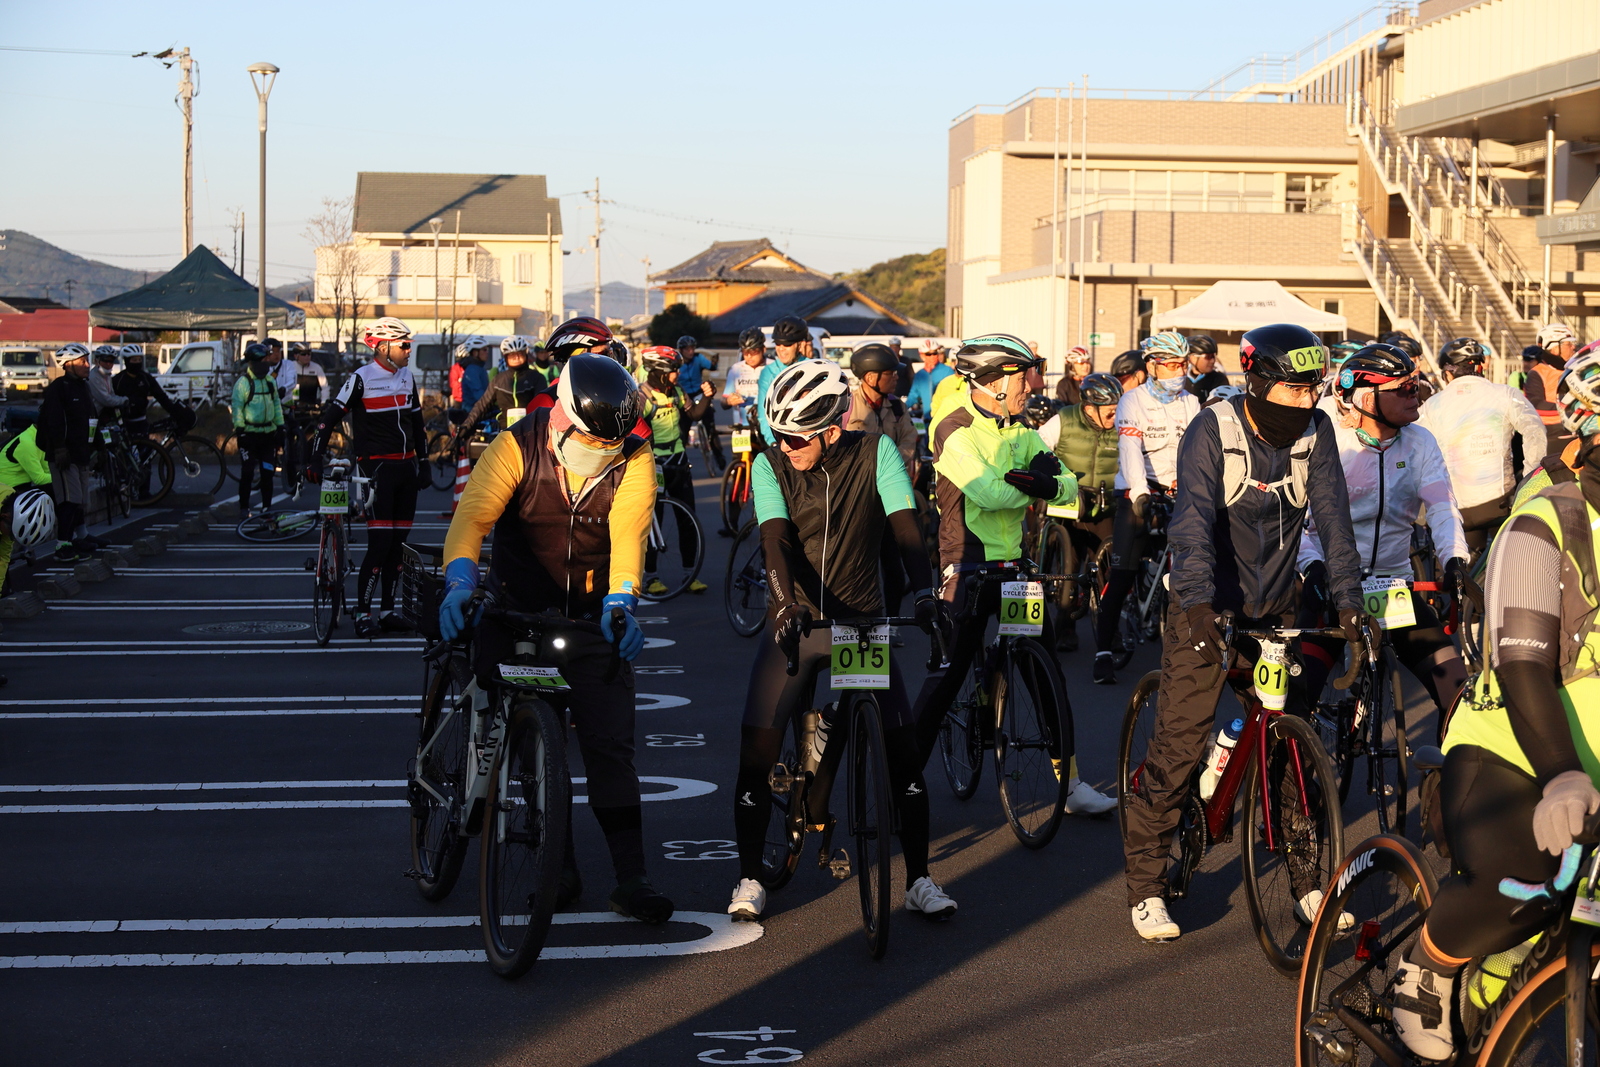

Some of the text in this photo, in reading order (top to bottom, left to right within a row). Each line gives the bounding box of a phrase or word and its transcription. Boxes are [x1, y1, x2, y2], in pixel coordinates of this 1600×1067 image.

[554, 333, 599, 348] HJC
[1295, 348, 1325, 367] 012
[1567, 378, 1591, 404] JAPAN
[324, 493, 346, 504] 034
[769, 569, 785, 602] SHIMANO
[1007, 601, 1041, 620] 018
[1367, 591, 1408, 614] 016
[833, 634, 855, 642] CYCLE
[1498, 637, 1549, 650] Santini
[838, 647, 884, 669] 015
[1258, 664, 1288, 690] 01
[644, 732, 707, 748] 62
[661, 839, 740, 861] 63
[1336, 847, 1377, 898] MAVIC
[692, 1026, 805, 1065] 64
